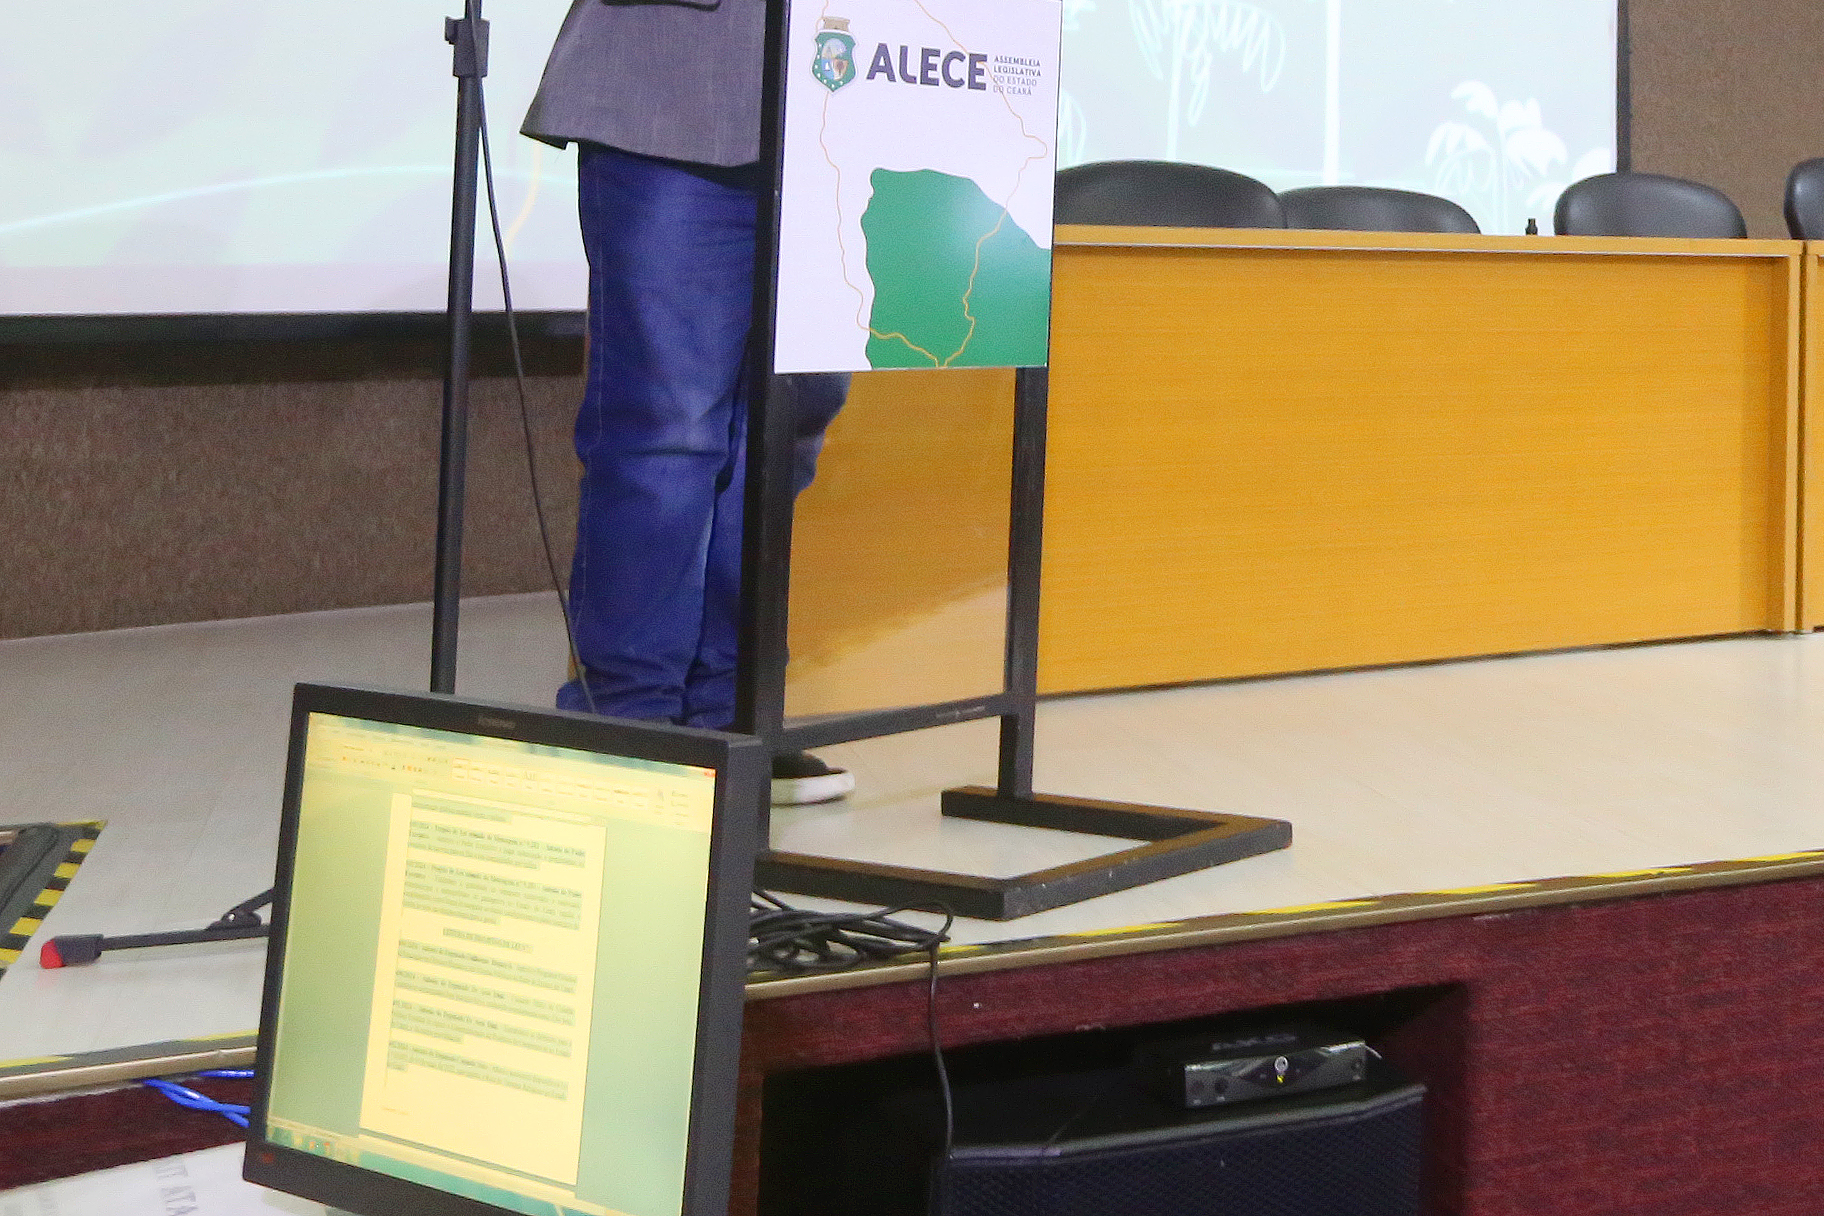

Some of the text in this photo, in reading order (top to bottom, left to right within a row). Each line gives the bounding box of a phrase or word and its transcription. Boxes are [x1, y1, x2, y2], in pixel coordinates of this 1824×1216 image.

[866, 42, 988, 91] ALECE
[994, 55, 1041, 67] ASSEMBLEIA
[993, 65, 1042, 77] LEGISLATIVA
[1007, 76, 1038, 86] ESTADO
